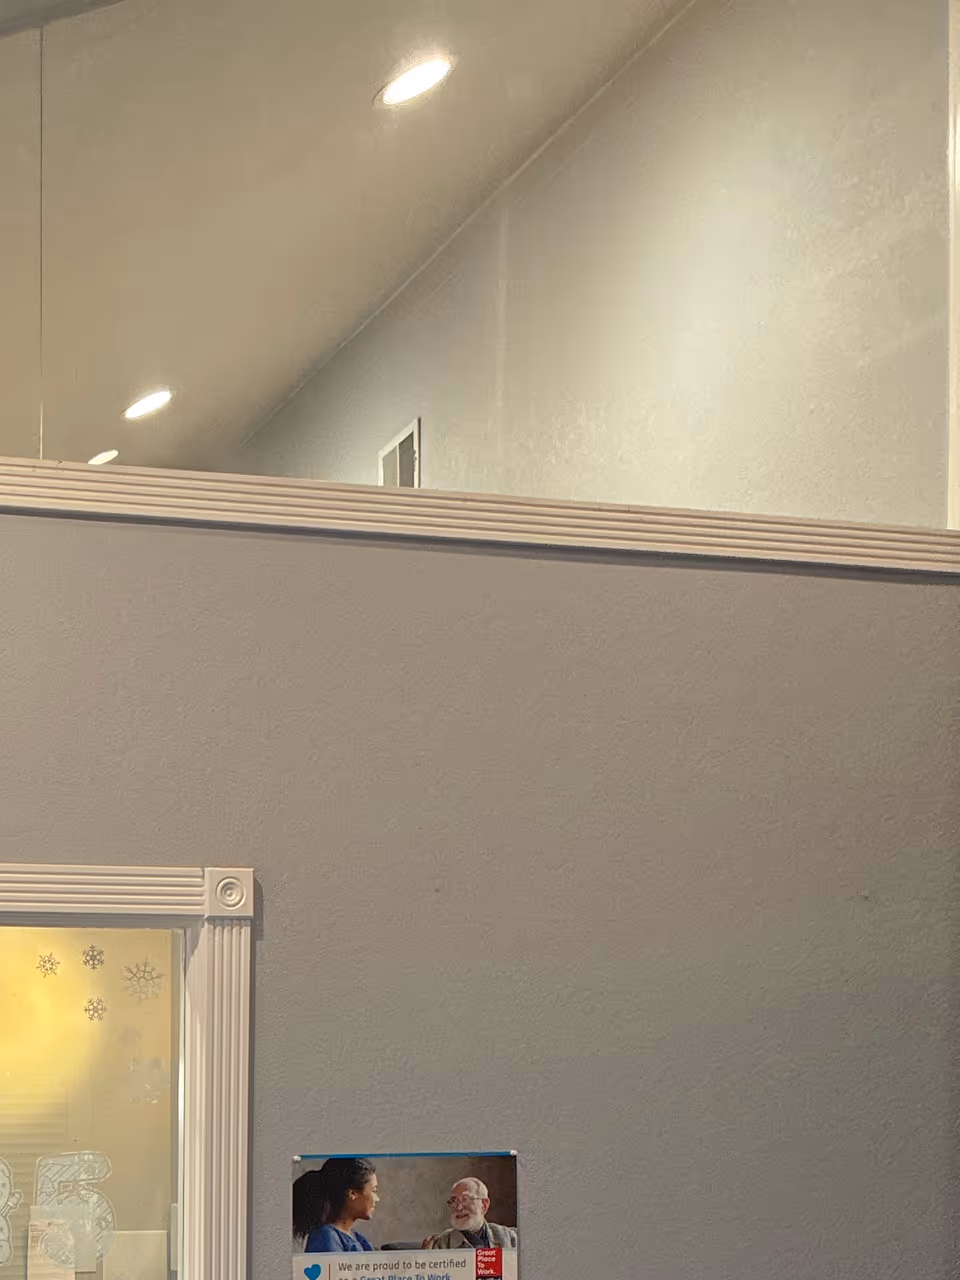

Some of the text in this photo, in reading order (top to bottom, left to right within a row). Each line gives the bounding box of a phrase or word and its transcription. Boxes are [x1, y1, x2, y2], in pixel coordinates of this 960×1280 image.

[338, 1258, 467, 1272] We are proud to be certified
